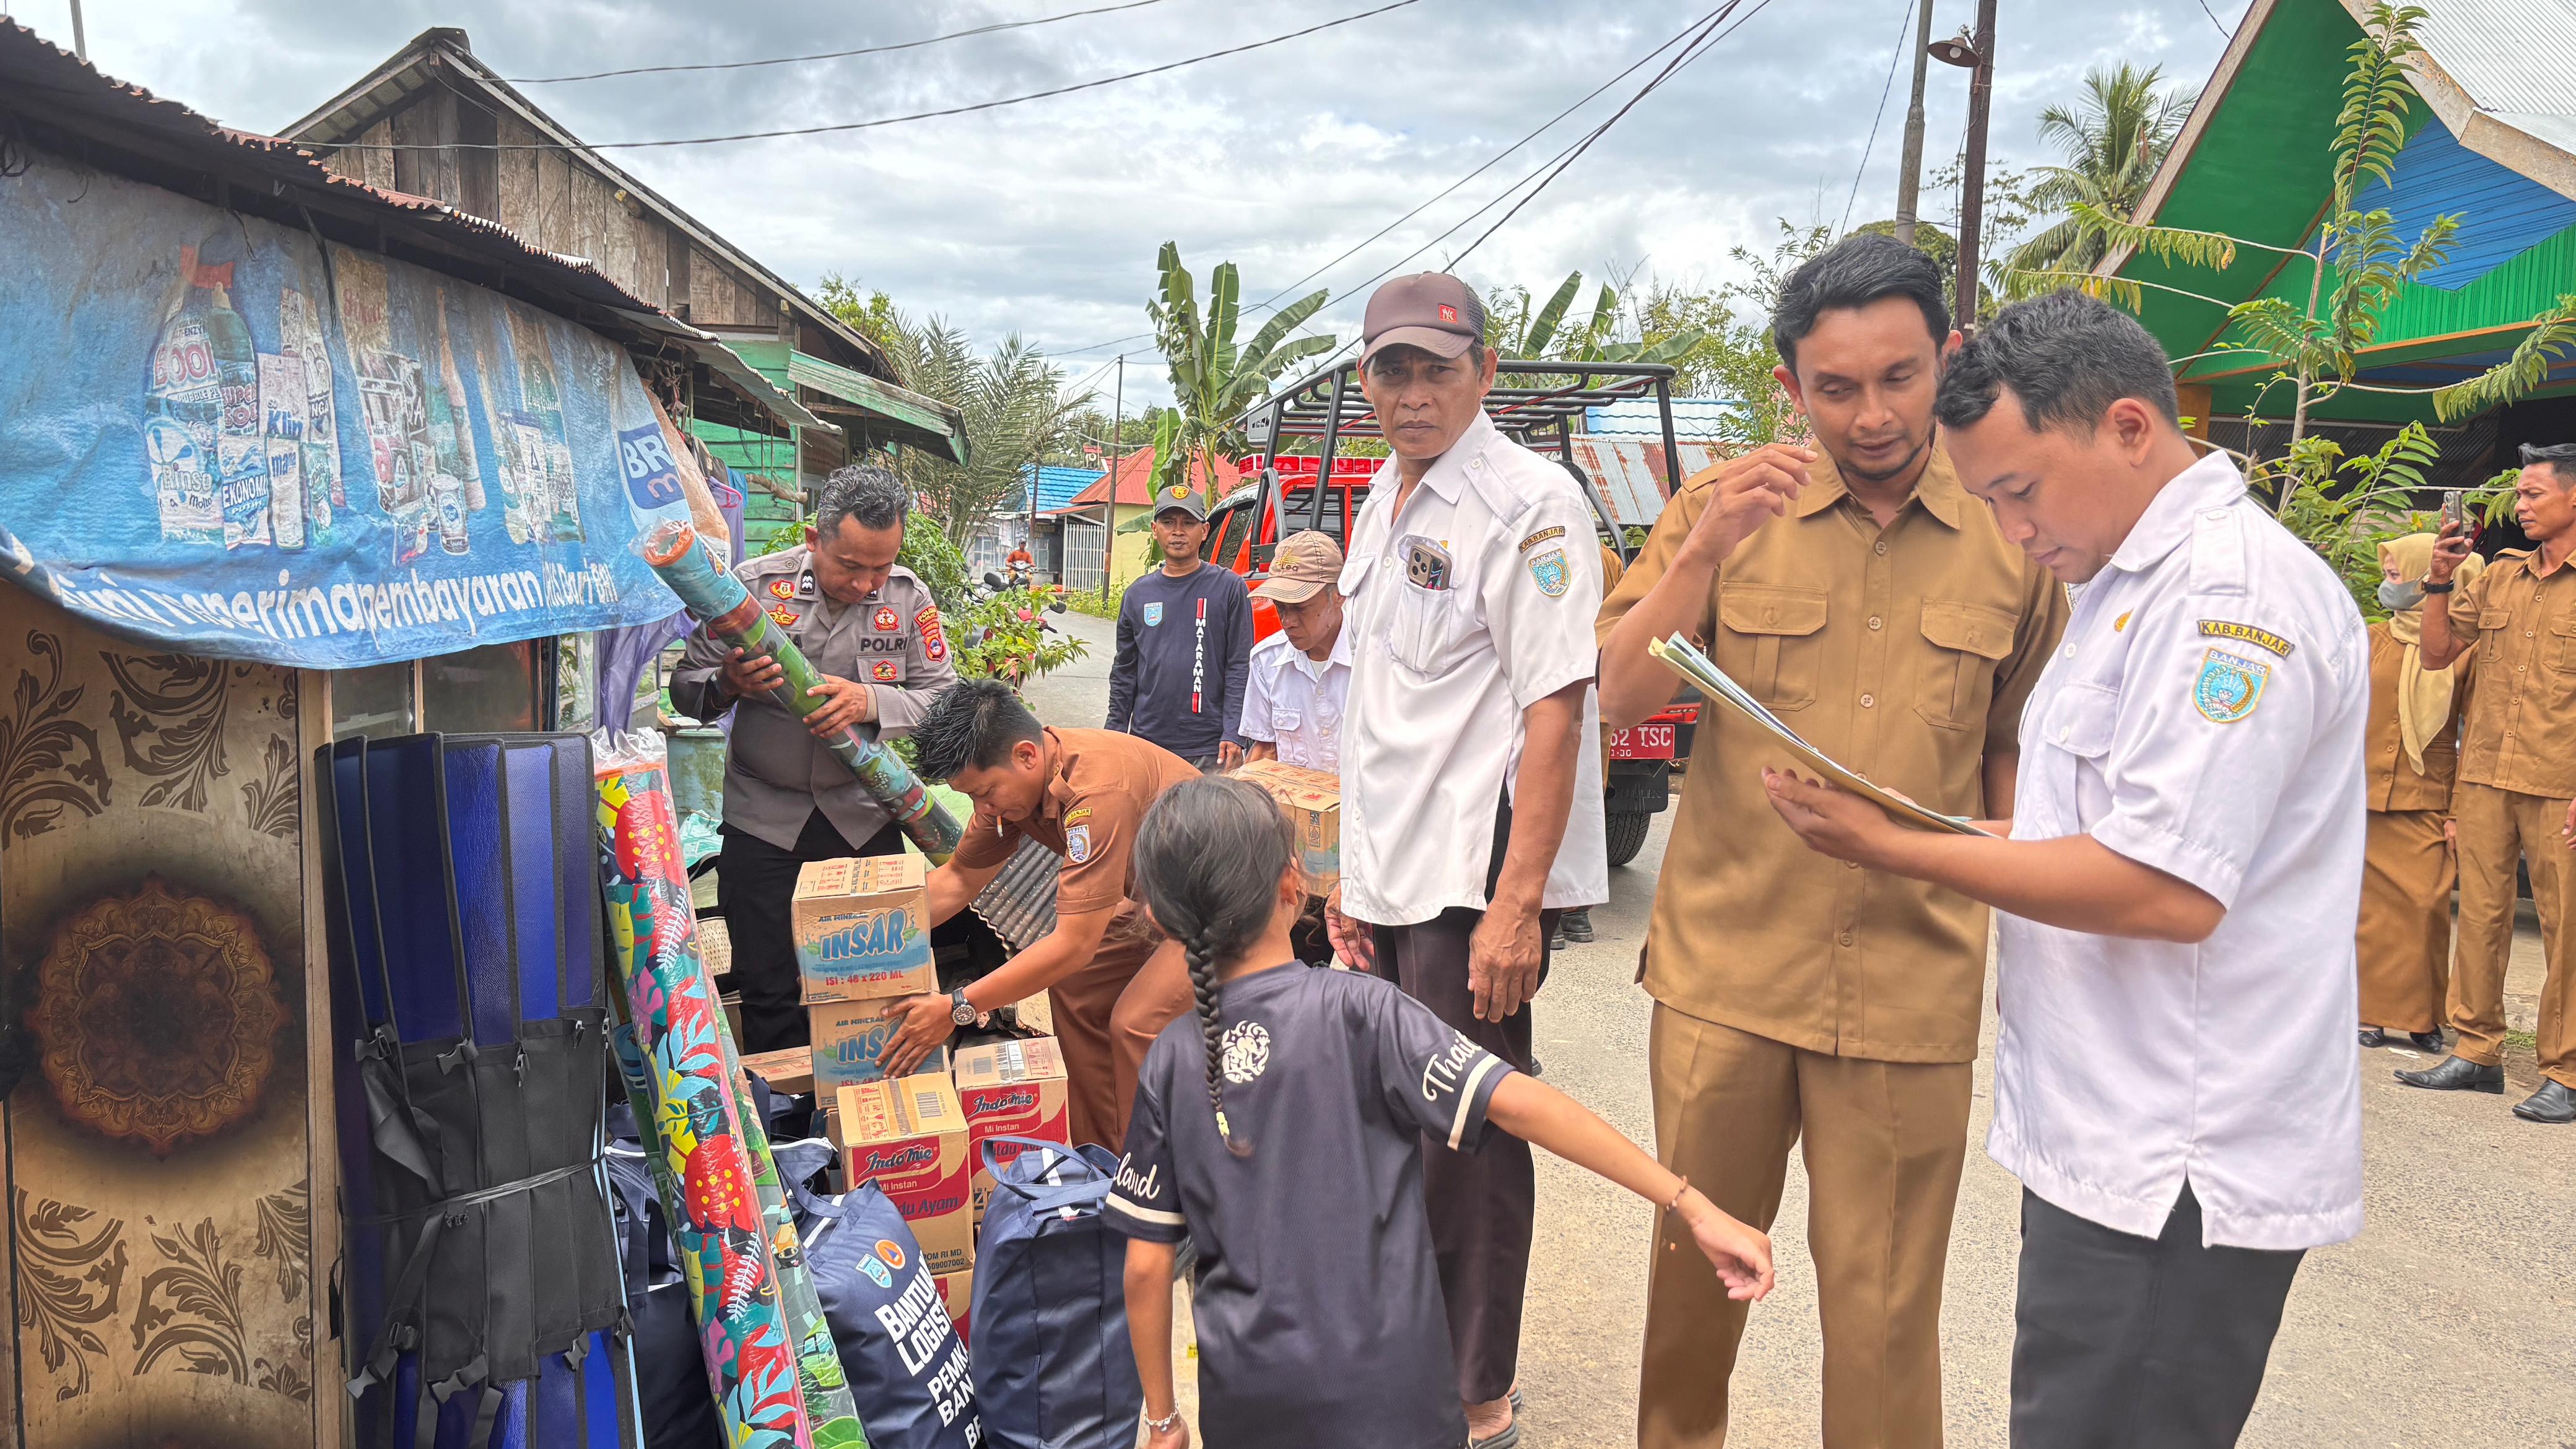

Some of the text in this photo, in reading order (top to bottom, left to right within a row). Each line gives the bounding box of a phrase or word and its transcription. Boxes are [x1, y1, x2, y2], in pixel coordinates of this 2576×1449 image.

[163, 462, 213, 493] Rinso
[222, 474, 268, 509] EKONOMI
[357, 567, 544, 650] pembayaran
[861, 637, 908, 651] POLRI
[1193, 618, 1207, 693] MATARAMAN
[2209, 650, 2266, 674] BANJAR
[1638, 726, 1671, 747] TSC
[820, 907, 908, 962] INSAR
[826, 977, 839, 986] ISI
[869, 972, 887, 982] 220
[890, 970, 903, 980] ML
[837, 1018, 901, 1065] INS
[996, 1123, 1020, 1132] Instan
[890, 1180, 918, 1190] Instan
[918, 1196, 959, 1216] Ayam
